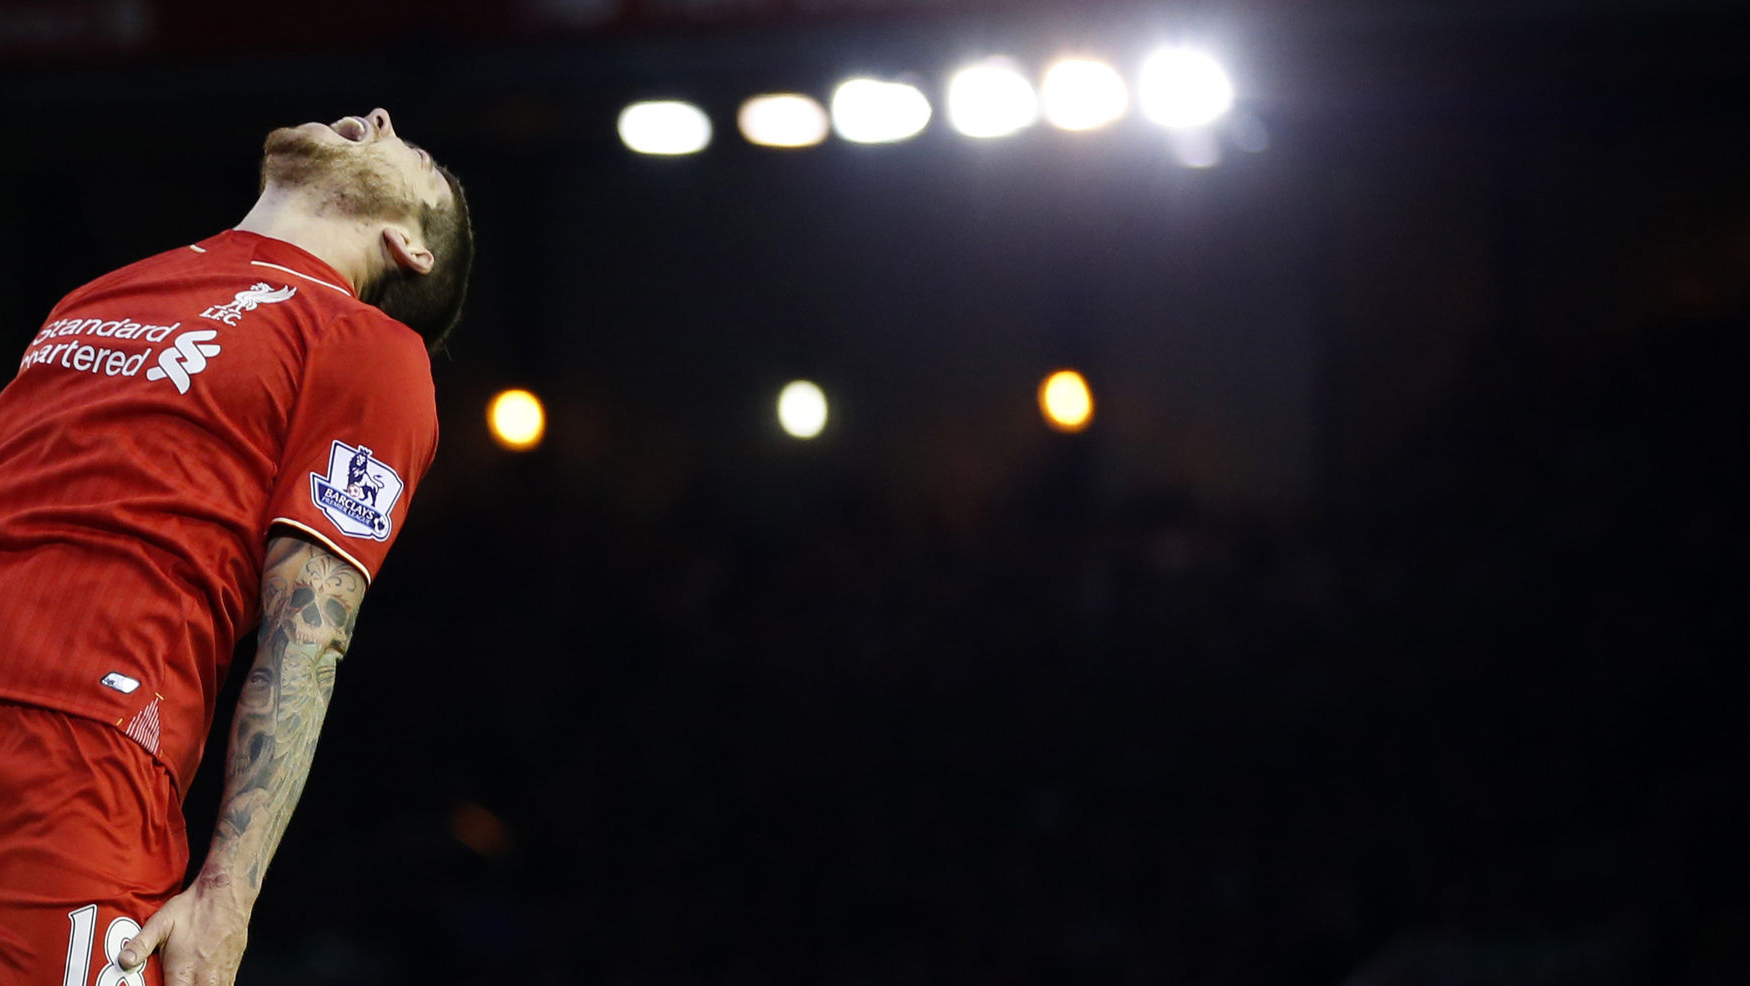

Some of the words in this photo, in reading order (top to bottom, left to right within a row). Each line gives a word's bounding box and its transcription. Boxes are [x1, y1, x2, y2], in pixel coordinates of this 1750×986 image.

[33, 318, 181, 346] Standard
[19, 340, 152, 376] hartered
[324, 488, 375, 520] BARCLAYS
